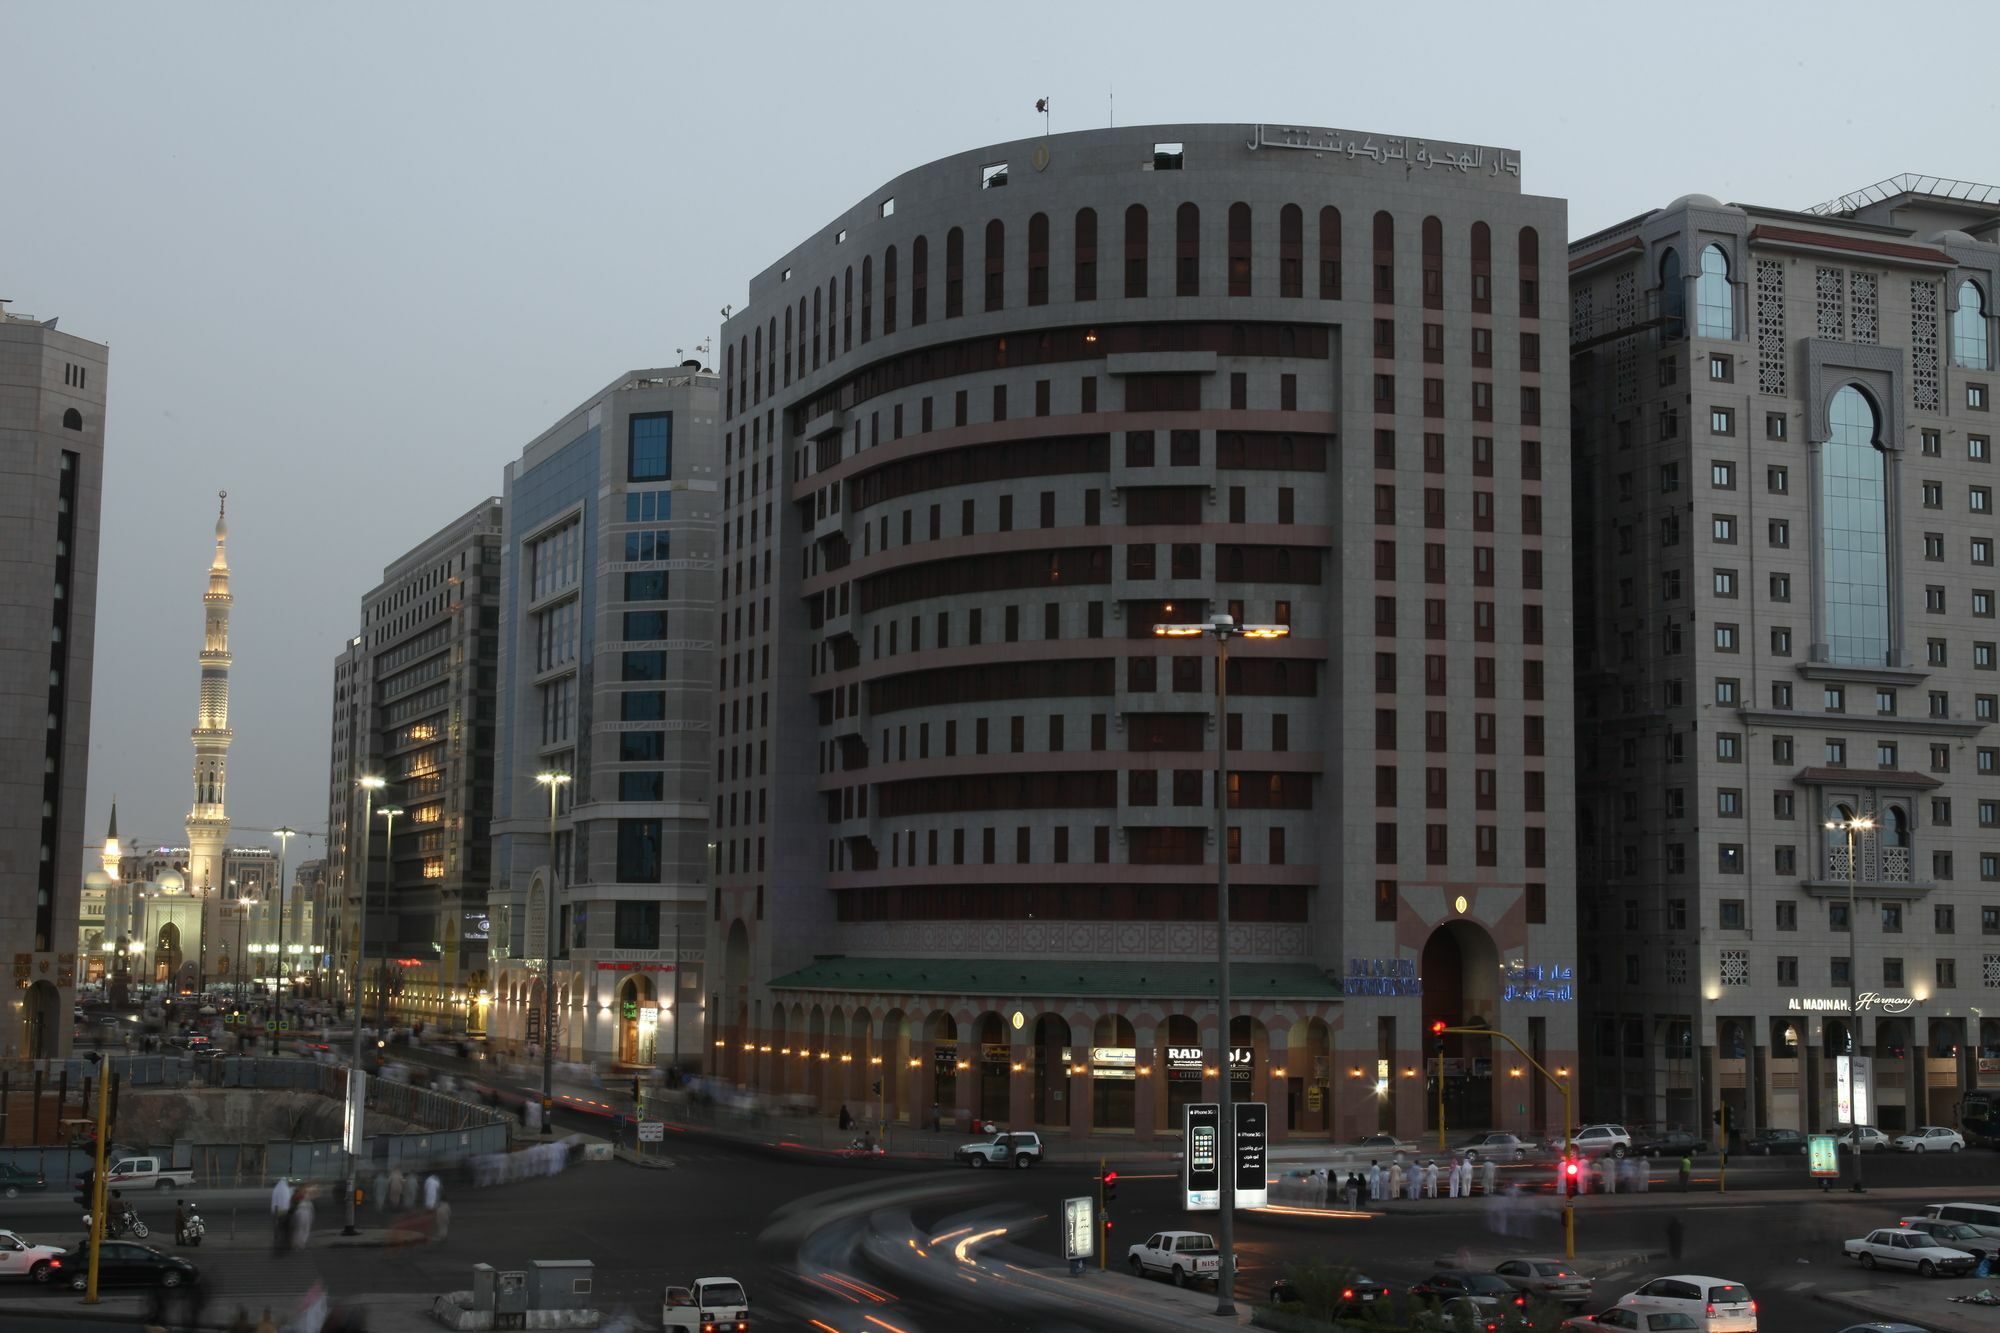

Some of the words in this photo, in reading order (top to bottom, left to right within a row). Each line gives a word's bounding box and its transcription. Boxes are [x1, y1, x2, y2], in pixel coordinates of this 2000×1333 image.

[1416, 140, 1483, 173] الهجرة
[1489, 150, 1520, 177] دار
[1788, 998, 1801, 1010] AL
[1803, 999, 1848, 1011] MADINAH
[1848, 992, 1915, 1013] Harmony
[1168, 1048, 1203, 1059] RAD
